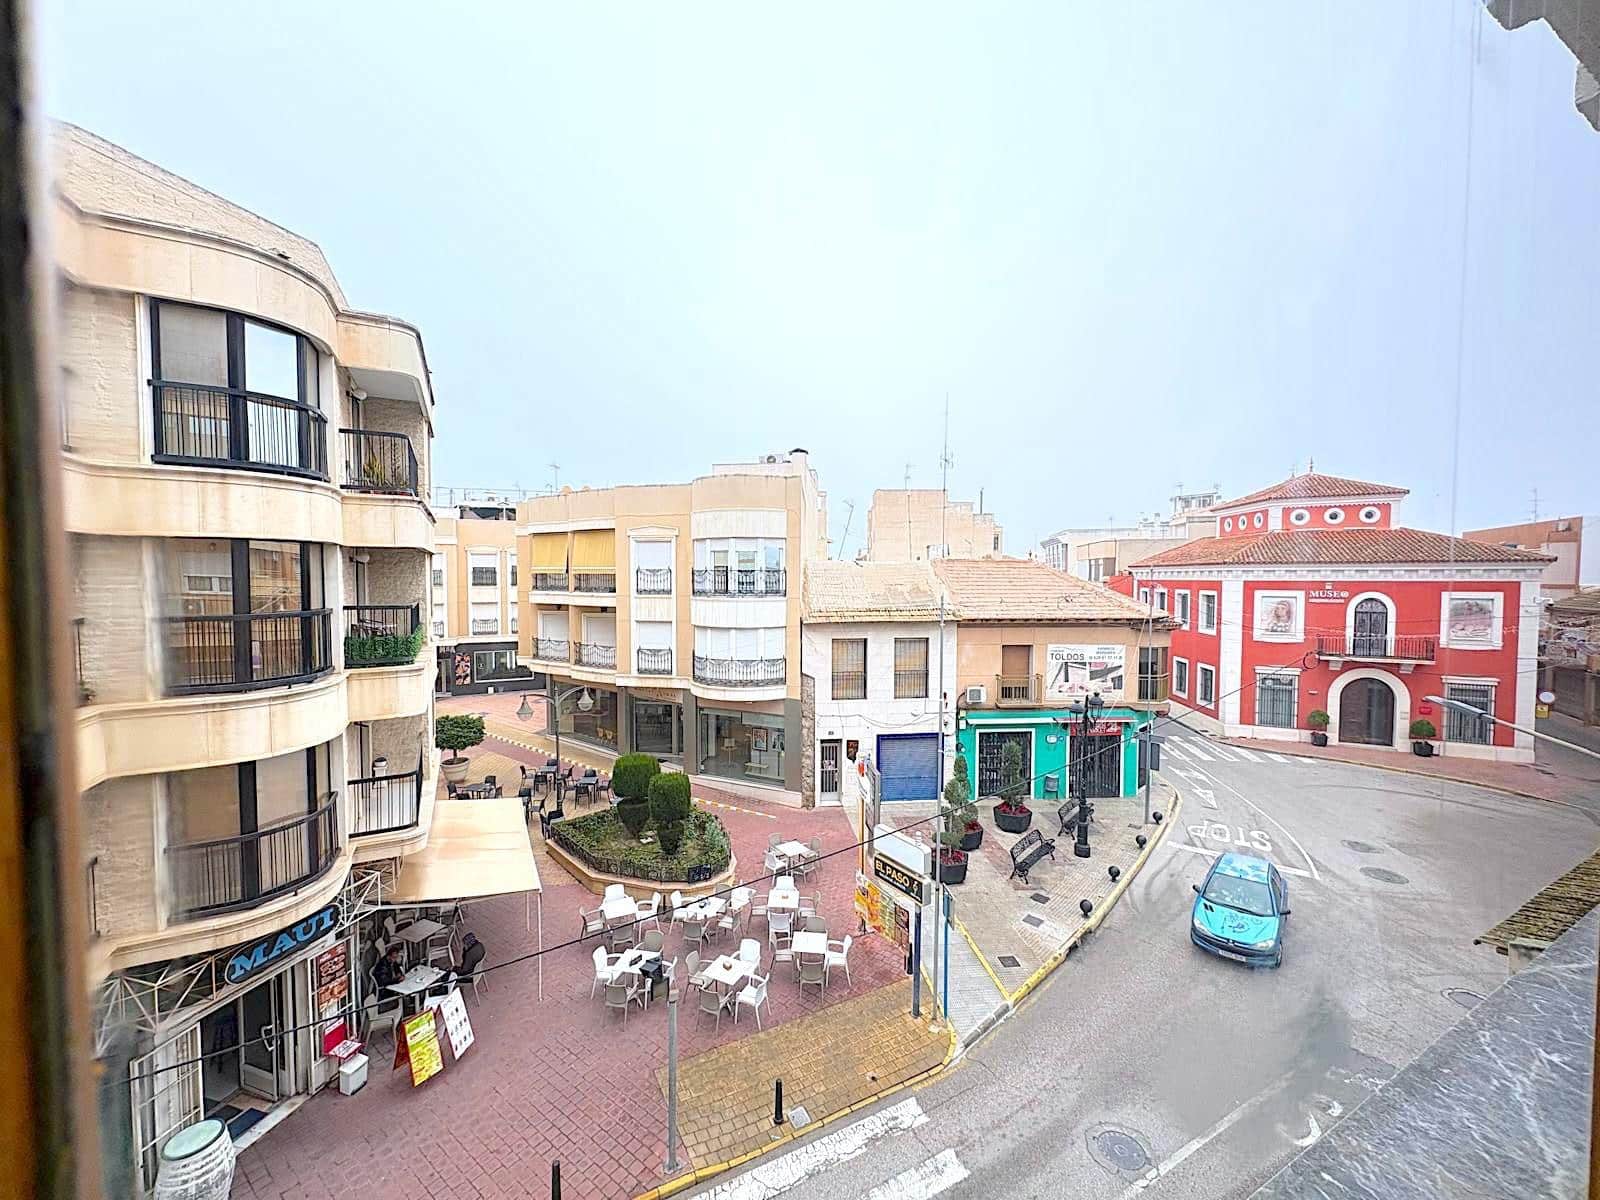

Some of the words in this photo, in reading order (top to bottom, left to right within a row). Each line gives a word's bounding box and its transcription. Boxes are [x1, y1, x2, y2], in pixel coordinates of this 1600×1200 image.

[1309, 590, 1349, 598] MUSEO
[1050, 653, 1085, 661] TOLDOS
[1187, 820, 1272, 852] STOP
[875, 860, 886, 874] EL
[886, 865, 910, 888] PASO
[230, 908, 334, 981] MAUI
